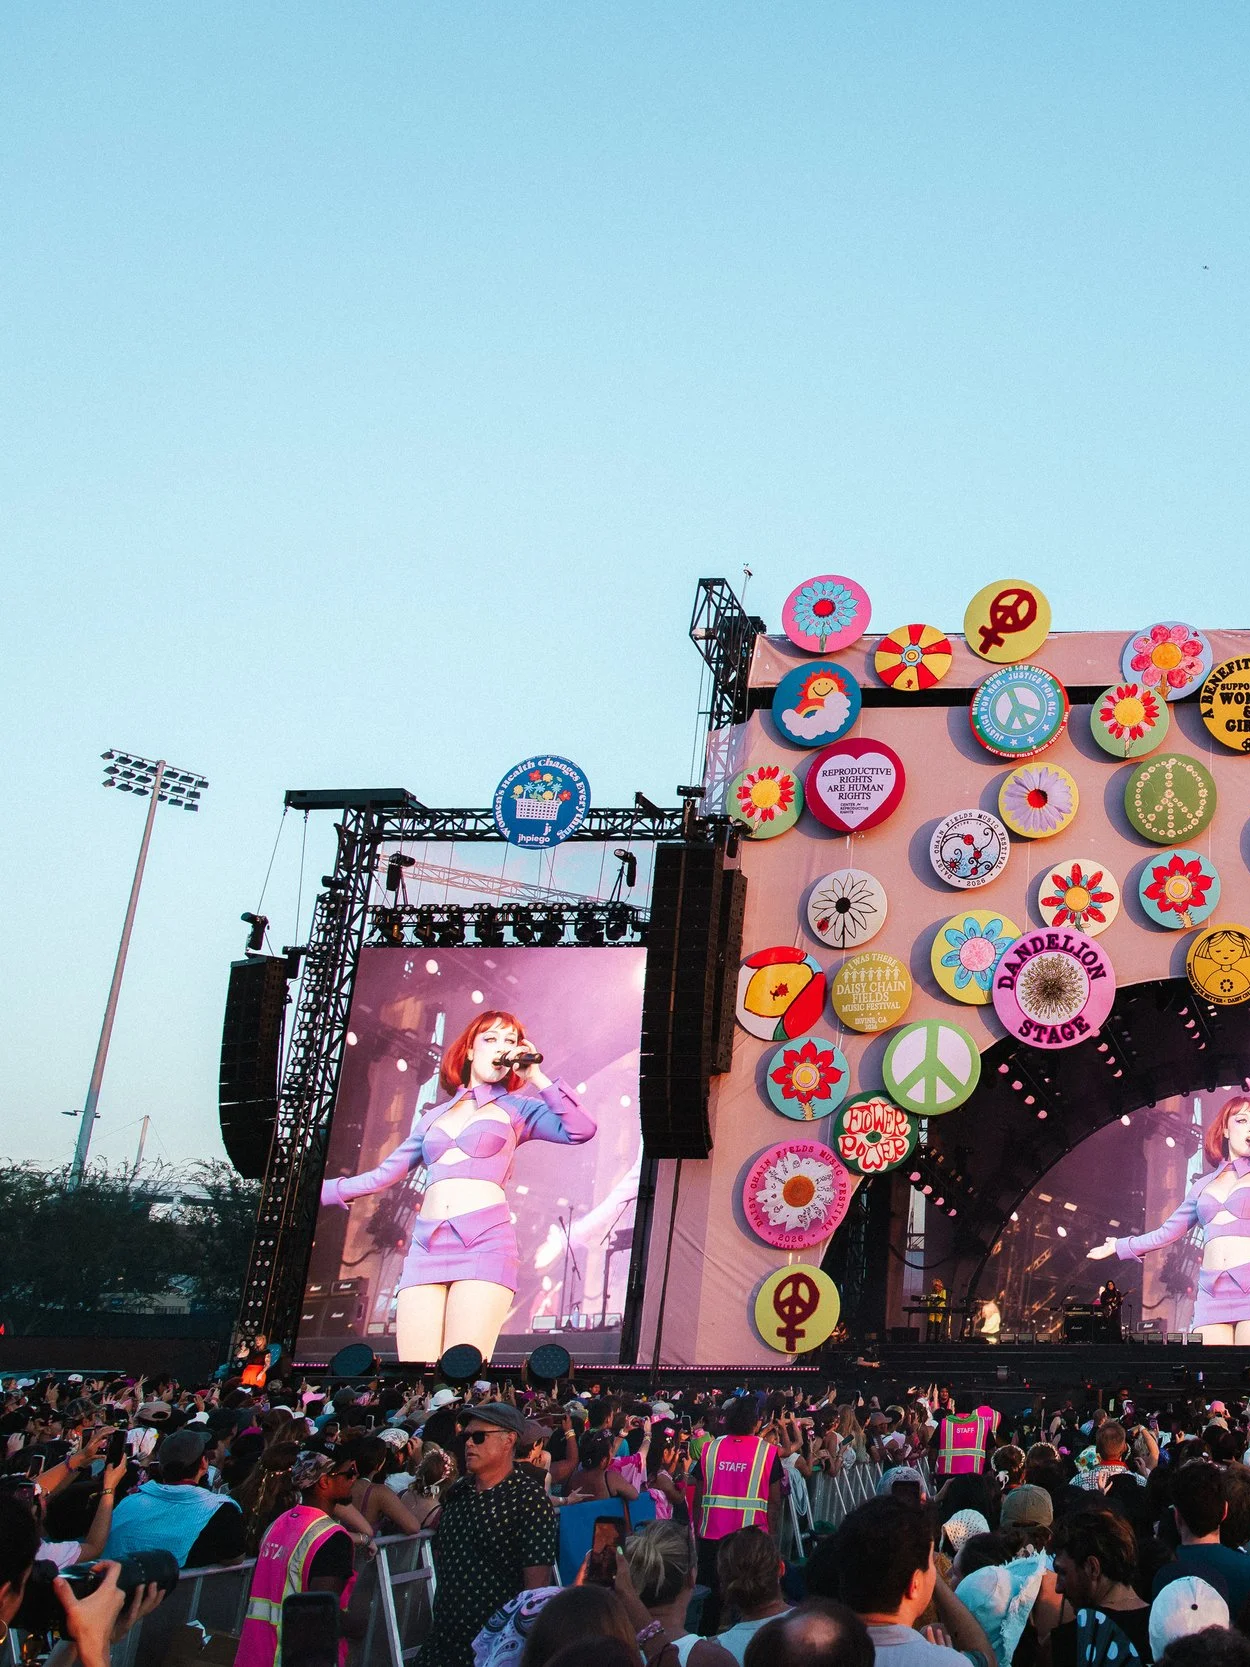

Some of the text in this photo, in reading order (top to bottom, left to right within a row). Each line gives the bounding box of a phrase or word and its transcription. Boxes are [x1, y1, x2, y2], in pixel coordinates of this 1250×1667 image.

[981, 696, 990, 712] FOR
[1008, 672, 1040, 684] JUSTICE
[1041, 683, 1053, 699] FOR
[1048, 701, 1056, 716] ALL
[1201, 658, 1250, 705] BENEFIT
[1202, 708, 1214, 719] A
[501, 760, 535, 789] Health
[537, 757, 580, 782] Changes
[822, 768, 891, 777] REPRODUCTIVE
[495, 790, 510, 838] Women's
[518, 834, 550, 844] jhpiego
[934, 813, 1007, 886] DAISY CHAIN FIELDS MUSIC FESTIVAL 2026
[853, 954, 869, 966] WAS
[872, 953, 898, 967] THERE
[998, 934, 1107, 990] DANDELION
[837, 981, 906, 995] DAISY CHAIN
[852, 992, 889, 1003] FIELDS
[842, 1002, 900, 1012] MUSIC FESTIVAL
[1018, 1016, 1091, 1044] STAGE
[776, 1145, 814, 1158] FIELDS
[820, 1150, 843, 1176] MUSIC
[750, 1159, 771, 1189] CHAIN
[749, 1197, 764, 1228] DAISY
[821, 1182, 846, 1232] FESTIVAL
[778, 1234, 804, 1242] 2026
[719, 1461, 747, 1472] STAFF
